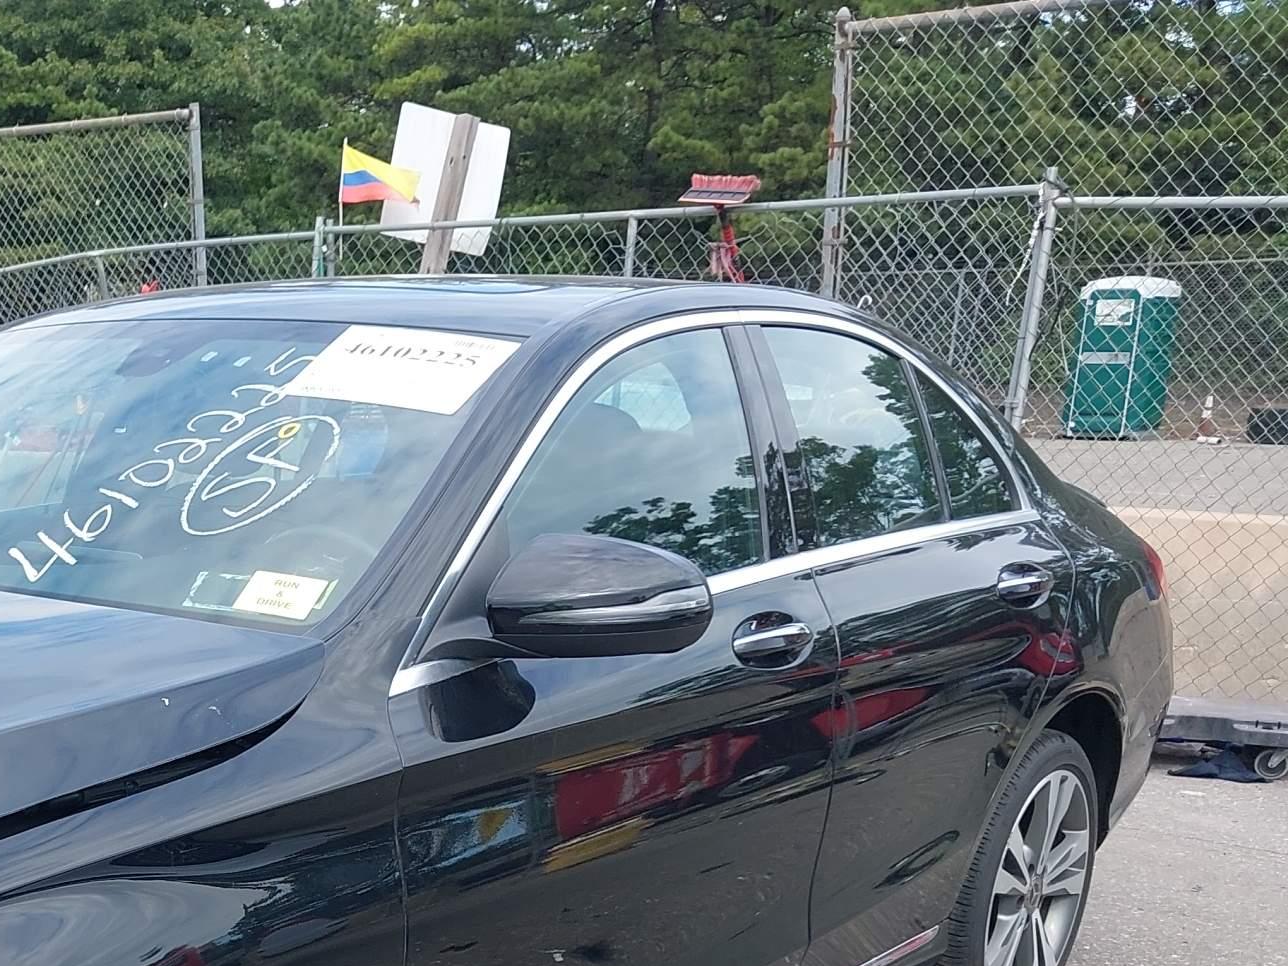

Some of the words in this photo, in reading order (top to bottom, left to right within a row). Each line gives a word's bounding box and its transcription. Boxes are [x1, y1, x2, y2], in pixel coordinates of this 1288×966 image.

[345, 343, 480, 366] 46102225
[274, 579, 300, 589] RUN
[257, 597, 294, 609] DRIVE
